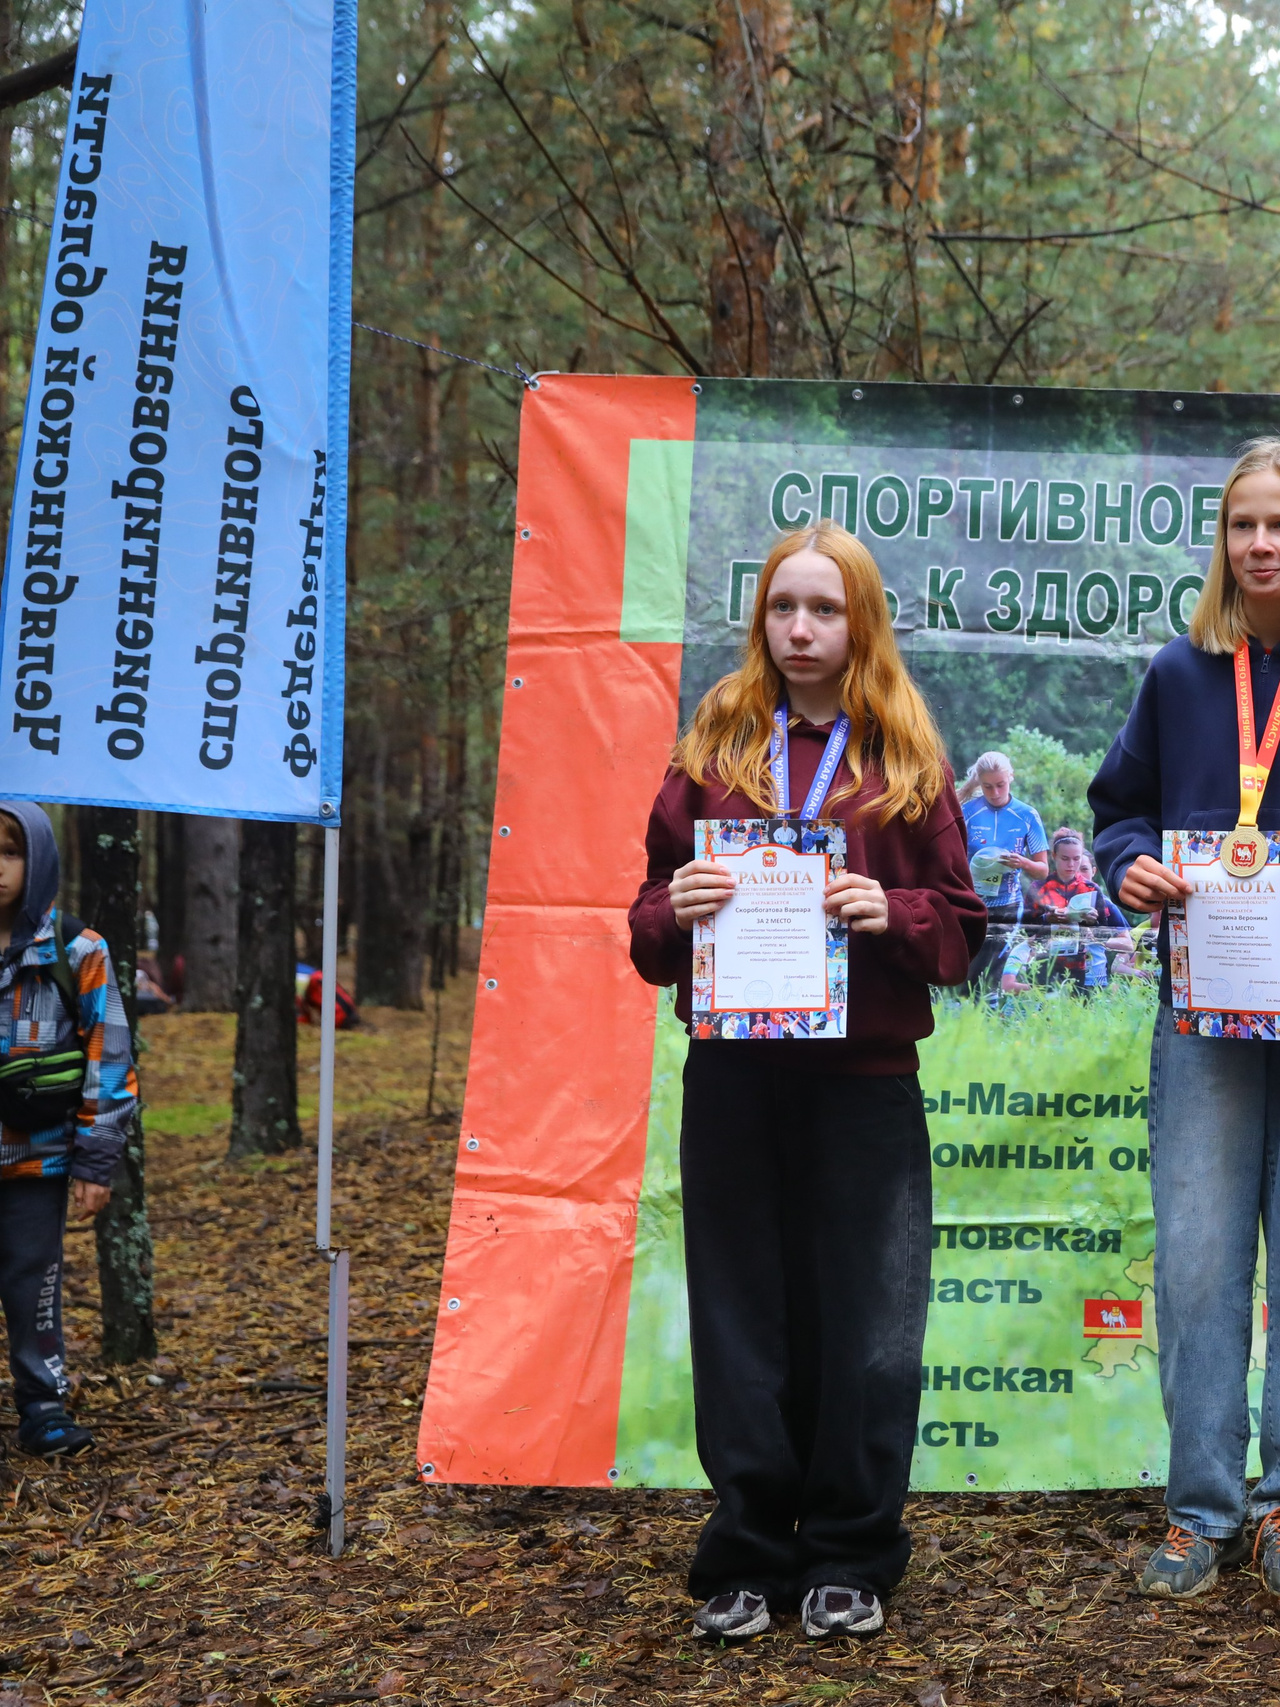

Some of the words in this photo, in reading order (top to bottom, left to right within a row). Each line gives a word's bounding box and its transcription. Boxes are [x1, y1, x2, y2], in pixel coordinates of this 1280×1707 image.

[771, 471, 1222, 546] СПОРТИВНОЕ
[926, 566, 965, 631] К
[1237, 646, 1247, 679] ОБЛАС
[1239, 680, 1252, 750] ЧЕЛЯБИНСКАЯ
[806, 780, 825, 820] ОБЛАСТ
[1193, 880, 1276, 894] ГРАМОТА
[921, 1082, 1149, 1119] ы-Мансий
[932, 1136, 1094, 1171] омный
[931, 1225, 1122, 1254] ловская
[929, 1277, 1043, 1304] асть
